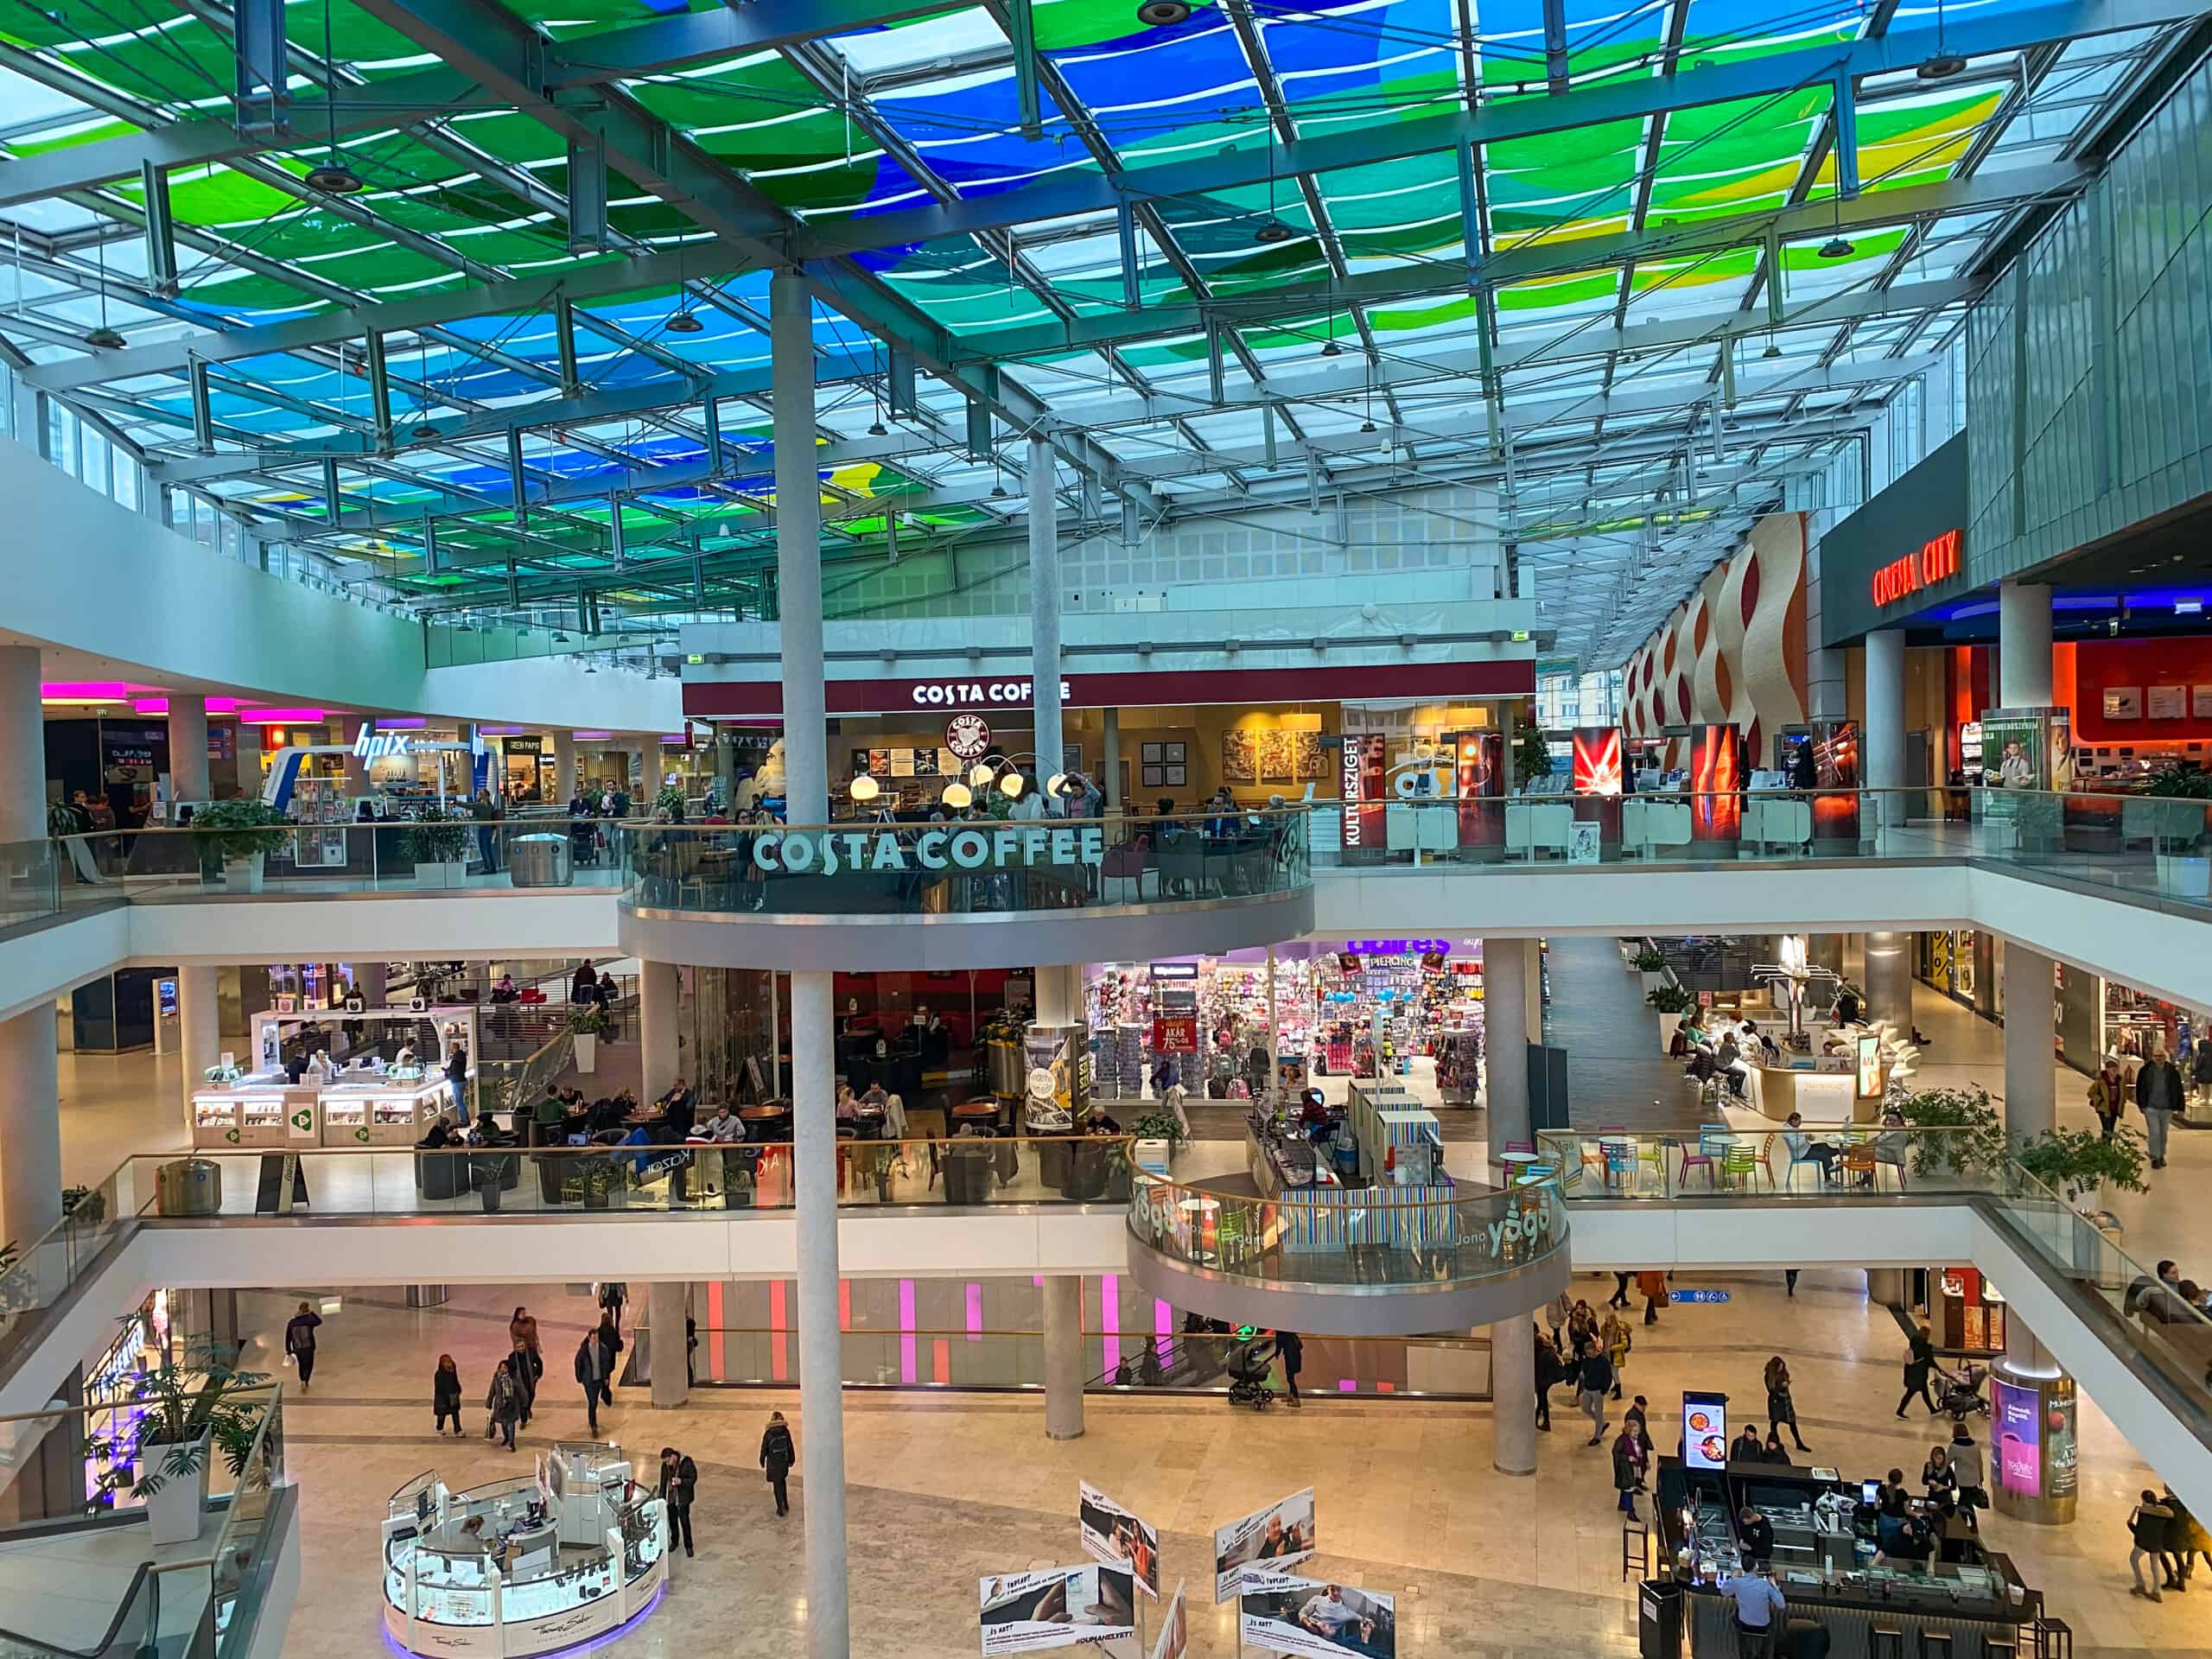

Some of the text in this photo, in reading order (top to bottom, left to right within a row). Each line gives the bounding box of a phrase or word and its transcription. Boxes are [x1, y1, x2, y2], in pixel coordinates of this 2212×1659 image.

[1873, 528, 1959, 607] CINEMA CITY
[912, 682, 1071, 705] COSTA COFE
[952, 716, 982, 729] COSTA
[353, 722, 410, 771] hpix
[950, 740, 986, 754] COFFEE
[753, 828, 1103, 876] COSTA COFFEE
[1370, 956, 1414, 968] PIERCING
